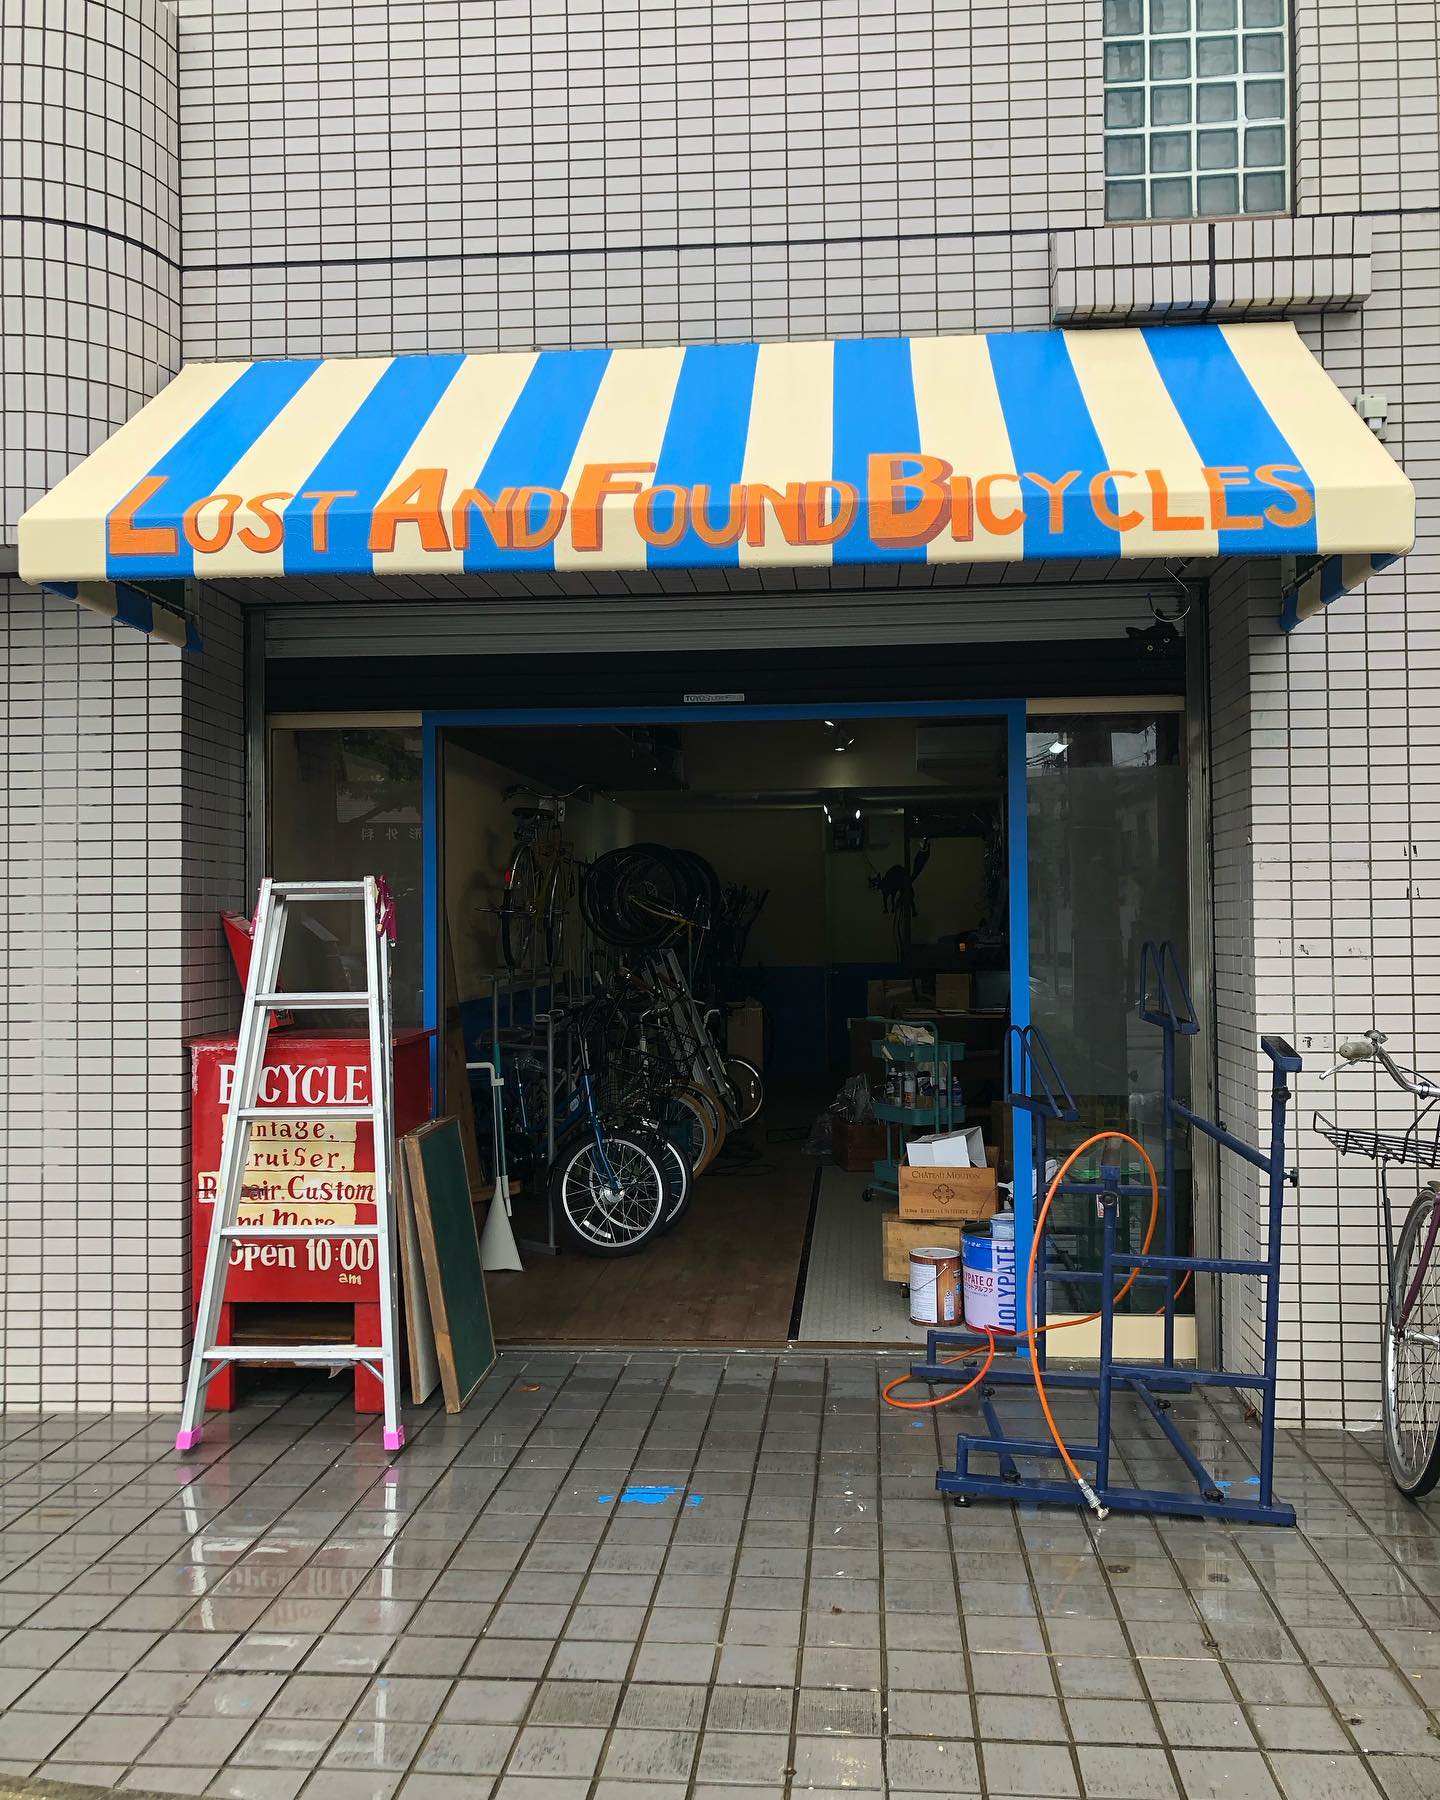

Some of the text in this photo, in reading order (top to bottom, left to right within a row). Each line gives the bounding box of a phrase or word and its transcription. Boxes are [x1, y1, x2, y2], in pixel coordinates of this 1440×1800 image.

[108, 453, 1316, 556] LOST AND FOUND BICYCLES
[218, 1064, 369, 1104] BCYCLE
[237, 1213, 263, 1226] nd
[229, 1238, 374, 1271] Open 10:00
[338, 1272, 362, 1285] am
